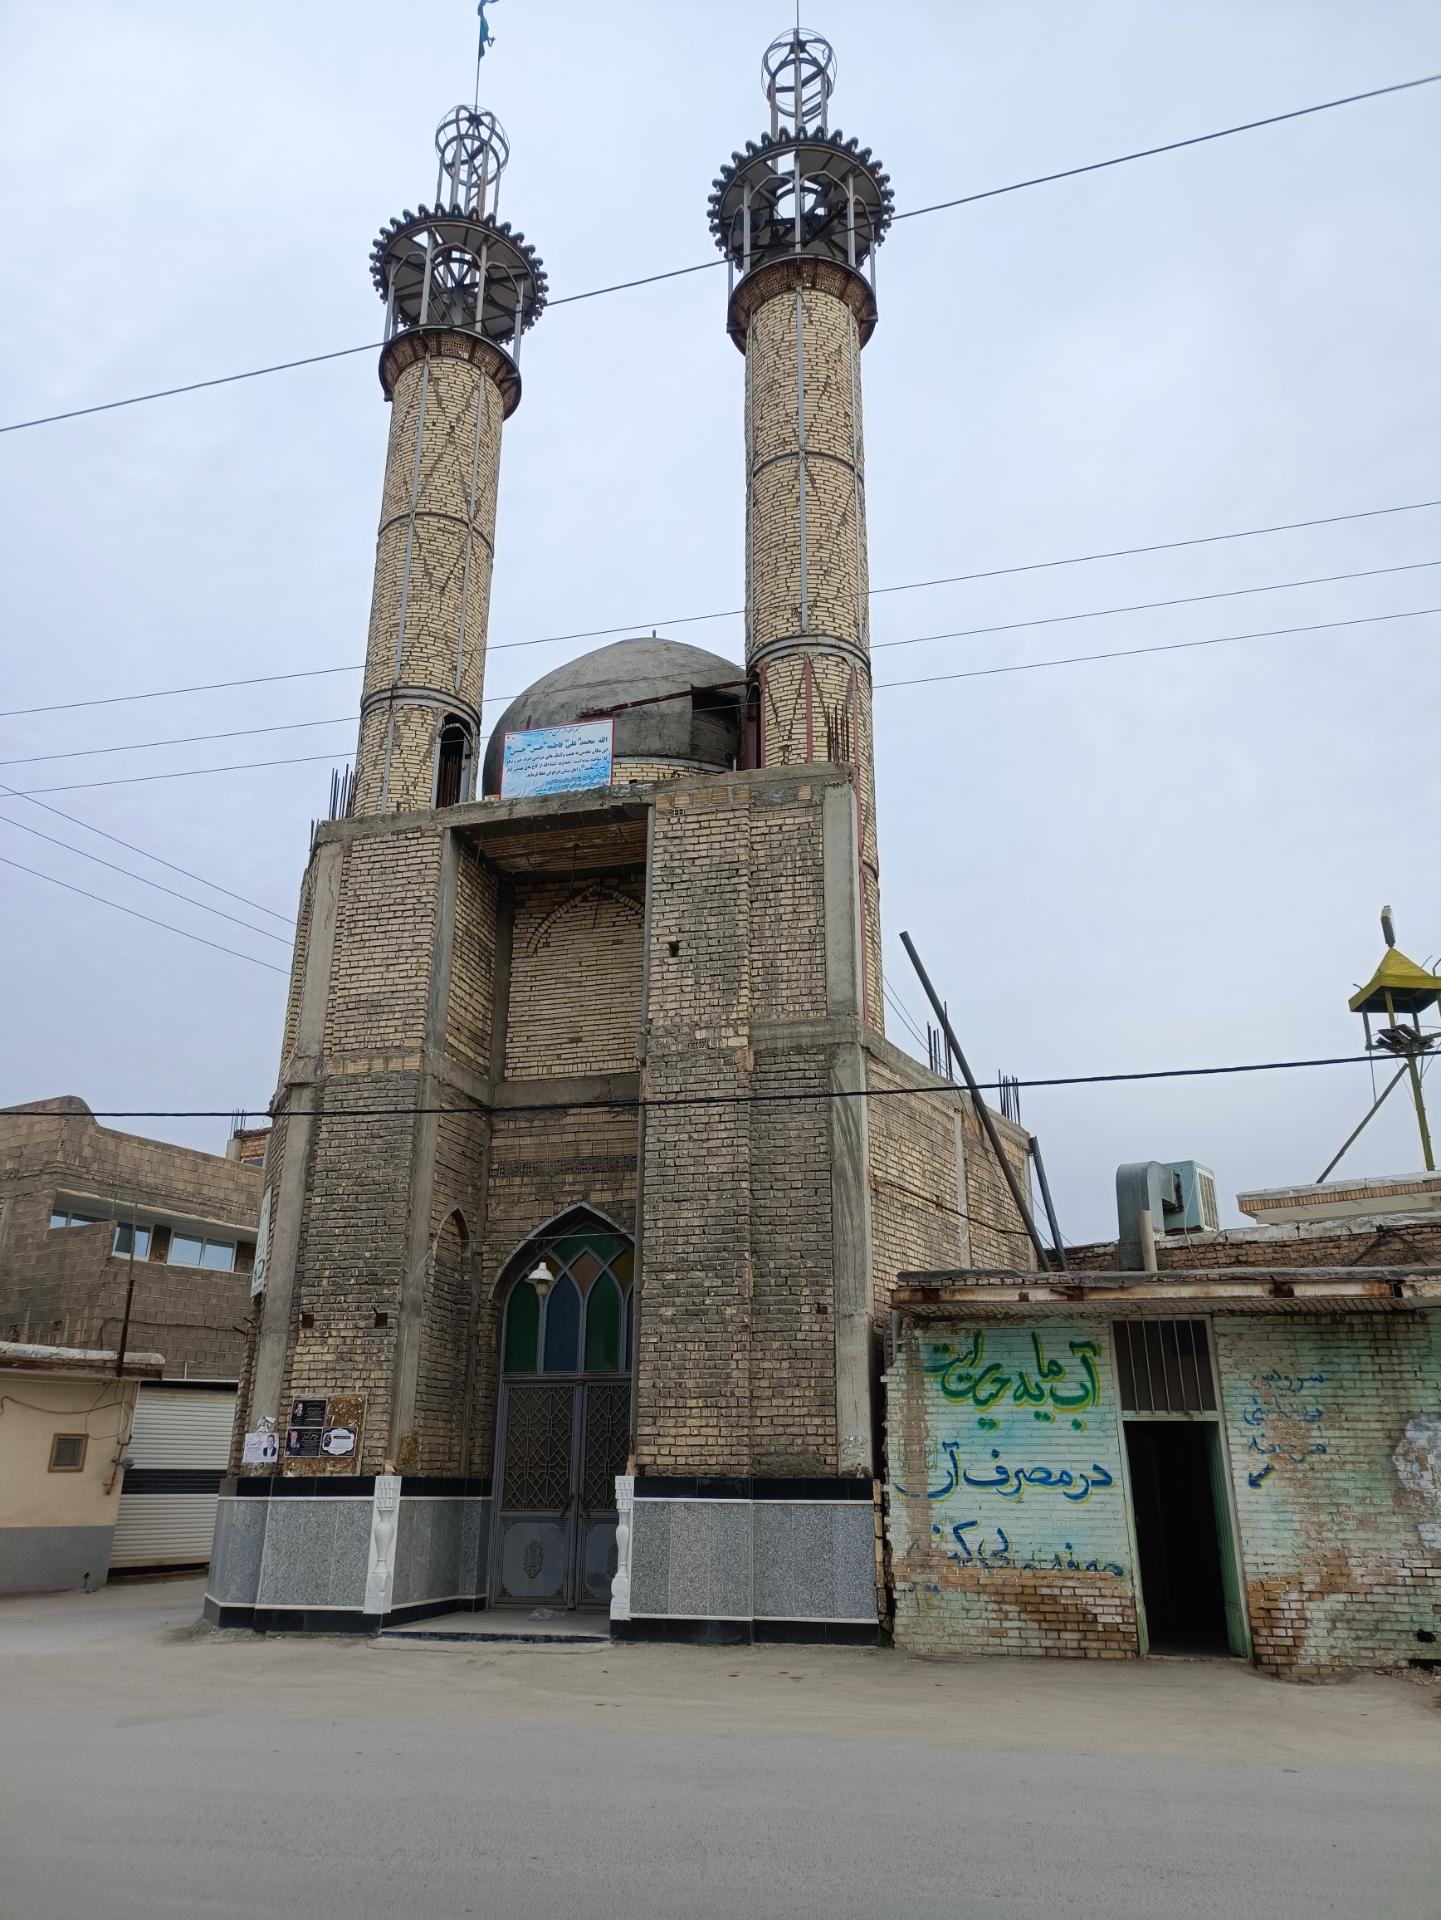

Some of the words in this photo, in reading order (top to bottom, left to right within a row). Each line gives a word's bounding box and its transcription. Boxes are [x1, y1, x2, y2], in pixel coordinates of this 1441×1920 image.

[1050, 1340, 1101, 1431] آب
[963, 1448, 1070, 1498] مصرف
[1063, 1463, 1113, 1501] در
